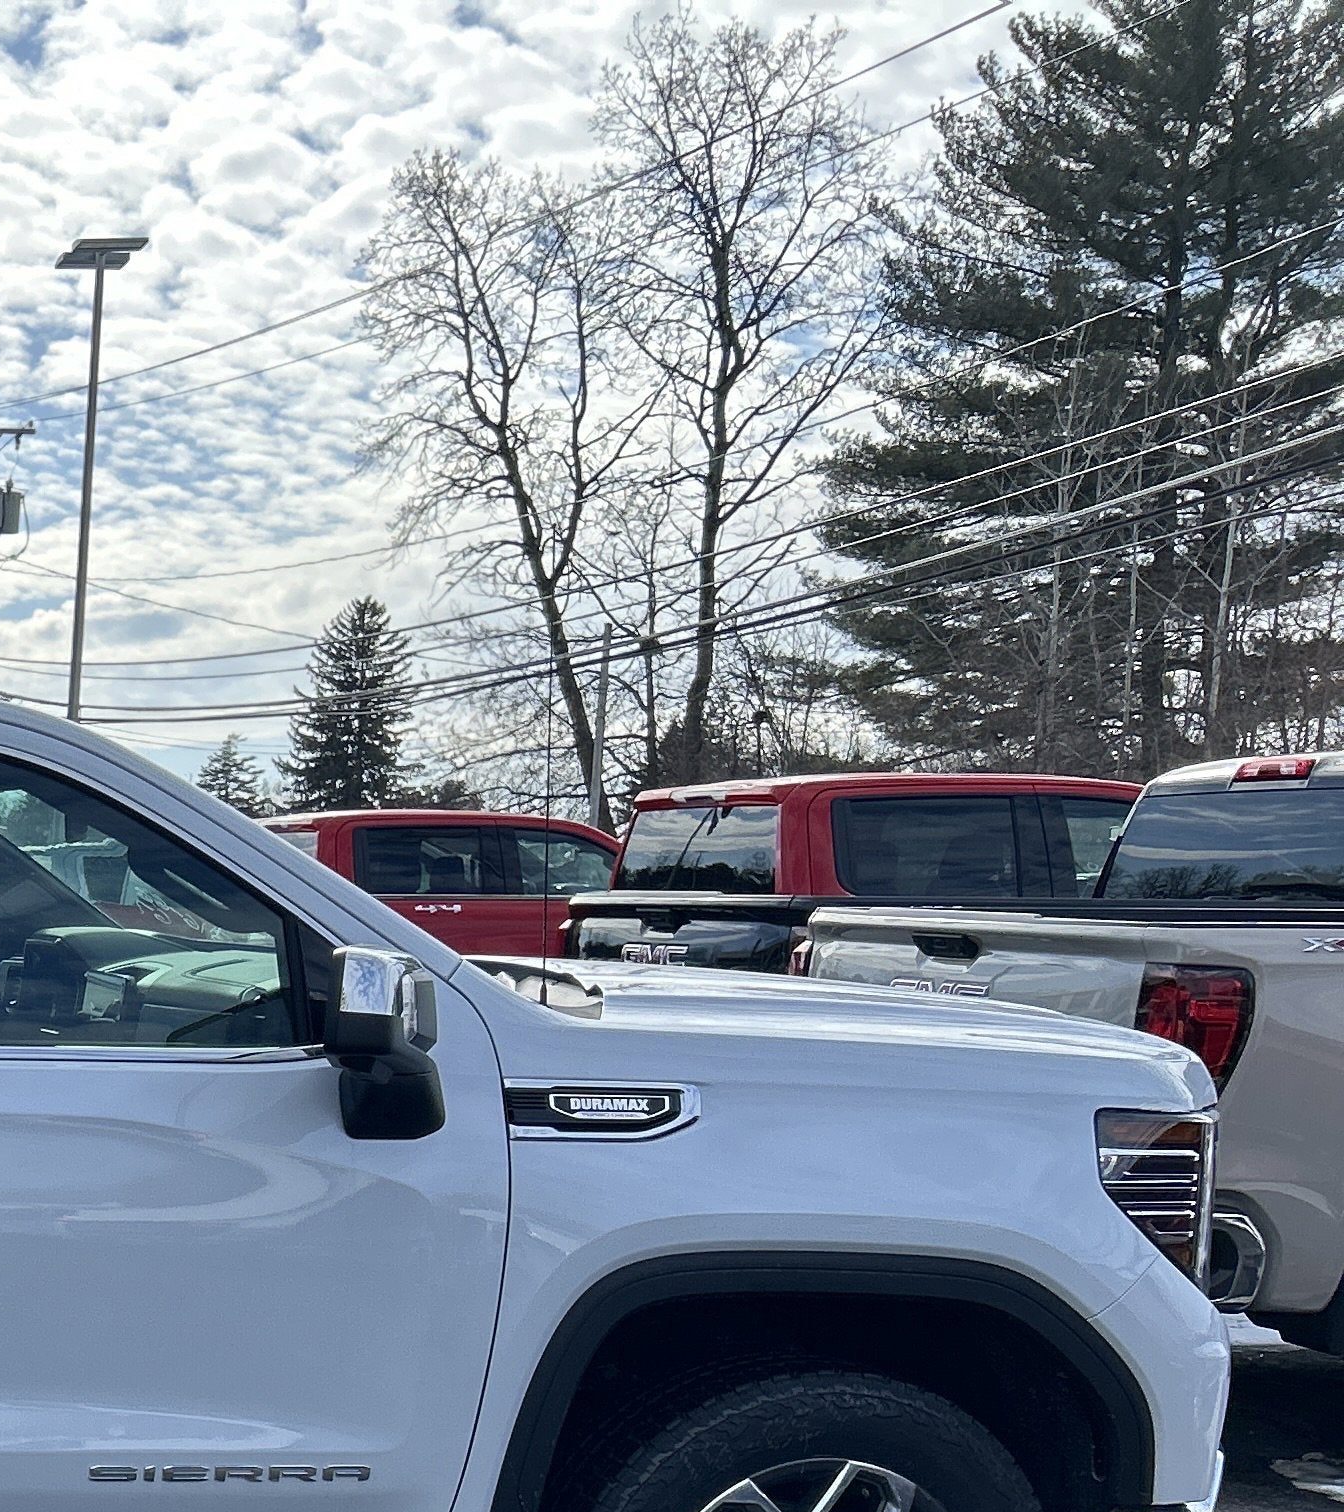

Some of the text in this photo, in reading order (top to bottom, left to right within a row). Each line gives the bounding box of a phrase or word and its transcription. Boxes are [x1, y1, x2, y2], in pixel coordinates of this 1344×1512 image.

[621, 943, 689, 967] GMC
[569, 1097, 650, 1111] DURAMAX
[88, 1464, 371, 1482] SIERRA
